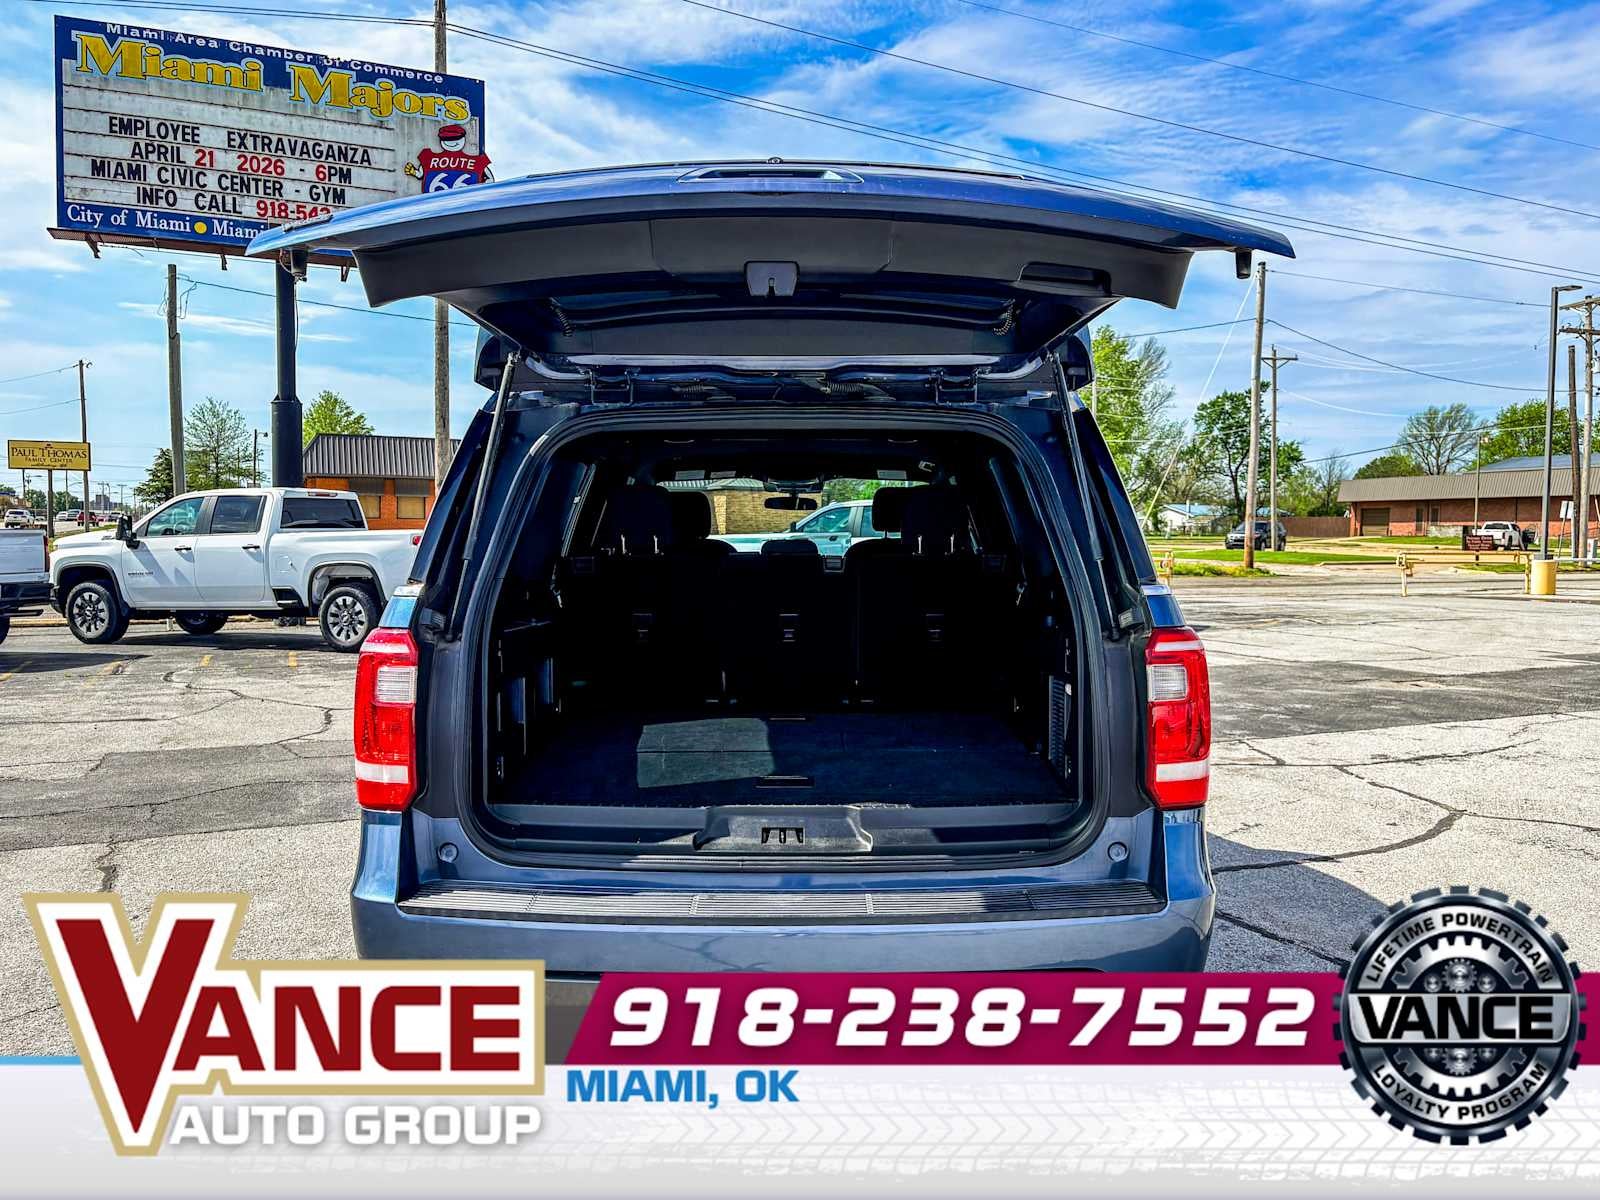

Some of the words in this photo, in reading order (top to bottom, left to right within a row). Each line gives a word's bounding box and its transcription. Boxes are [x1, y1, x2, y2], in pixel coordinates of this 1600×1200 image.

[106, 23, 165, 41] Miami
[175, 32, 219, 49] Area
[229, 41, 313, 63] Chamber
[350, 60, 444, 84] Commerce
[75, 33, 264, 92] Miami
[289, 64, 469, 121] Majors
[108, 116, 200, 144] EMPLOYEE
[227, 130, 372, 166] EXTRAVAGANZA
[130, 141, 186, 165] APRIL
[194, 148, 216, 168] 21
[236, 154, 285, 176] 2026
[315, 164, 352, 185] 6PM
[430, 157, 476, 169] ROUTE
[91, 159, 147, 182] MIAMI
[157, 166, 208, 189] CIVIC
[217, 173, 284, 198] CENTER
[308, 184, 346, 204] GYM
[136, 186, 177, 208] INFO
[194, 193, 243, 215] CALL
[67, 204, 104, 228] City
[111, 209, 129, 226] of
[135, 211, 192, 233] Miami
[11, 447, 38, 457] PAUL
[39, 447, 87, 459] THOMAS
